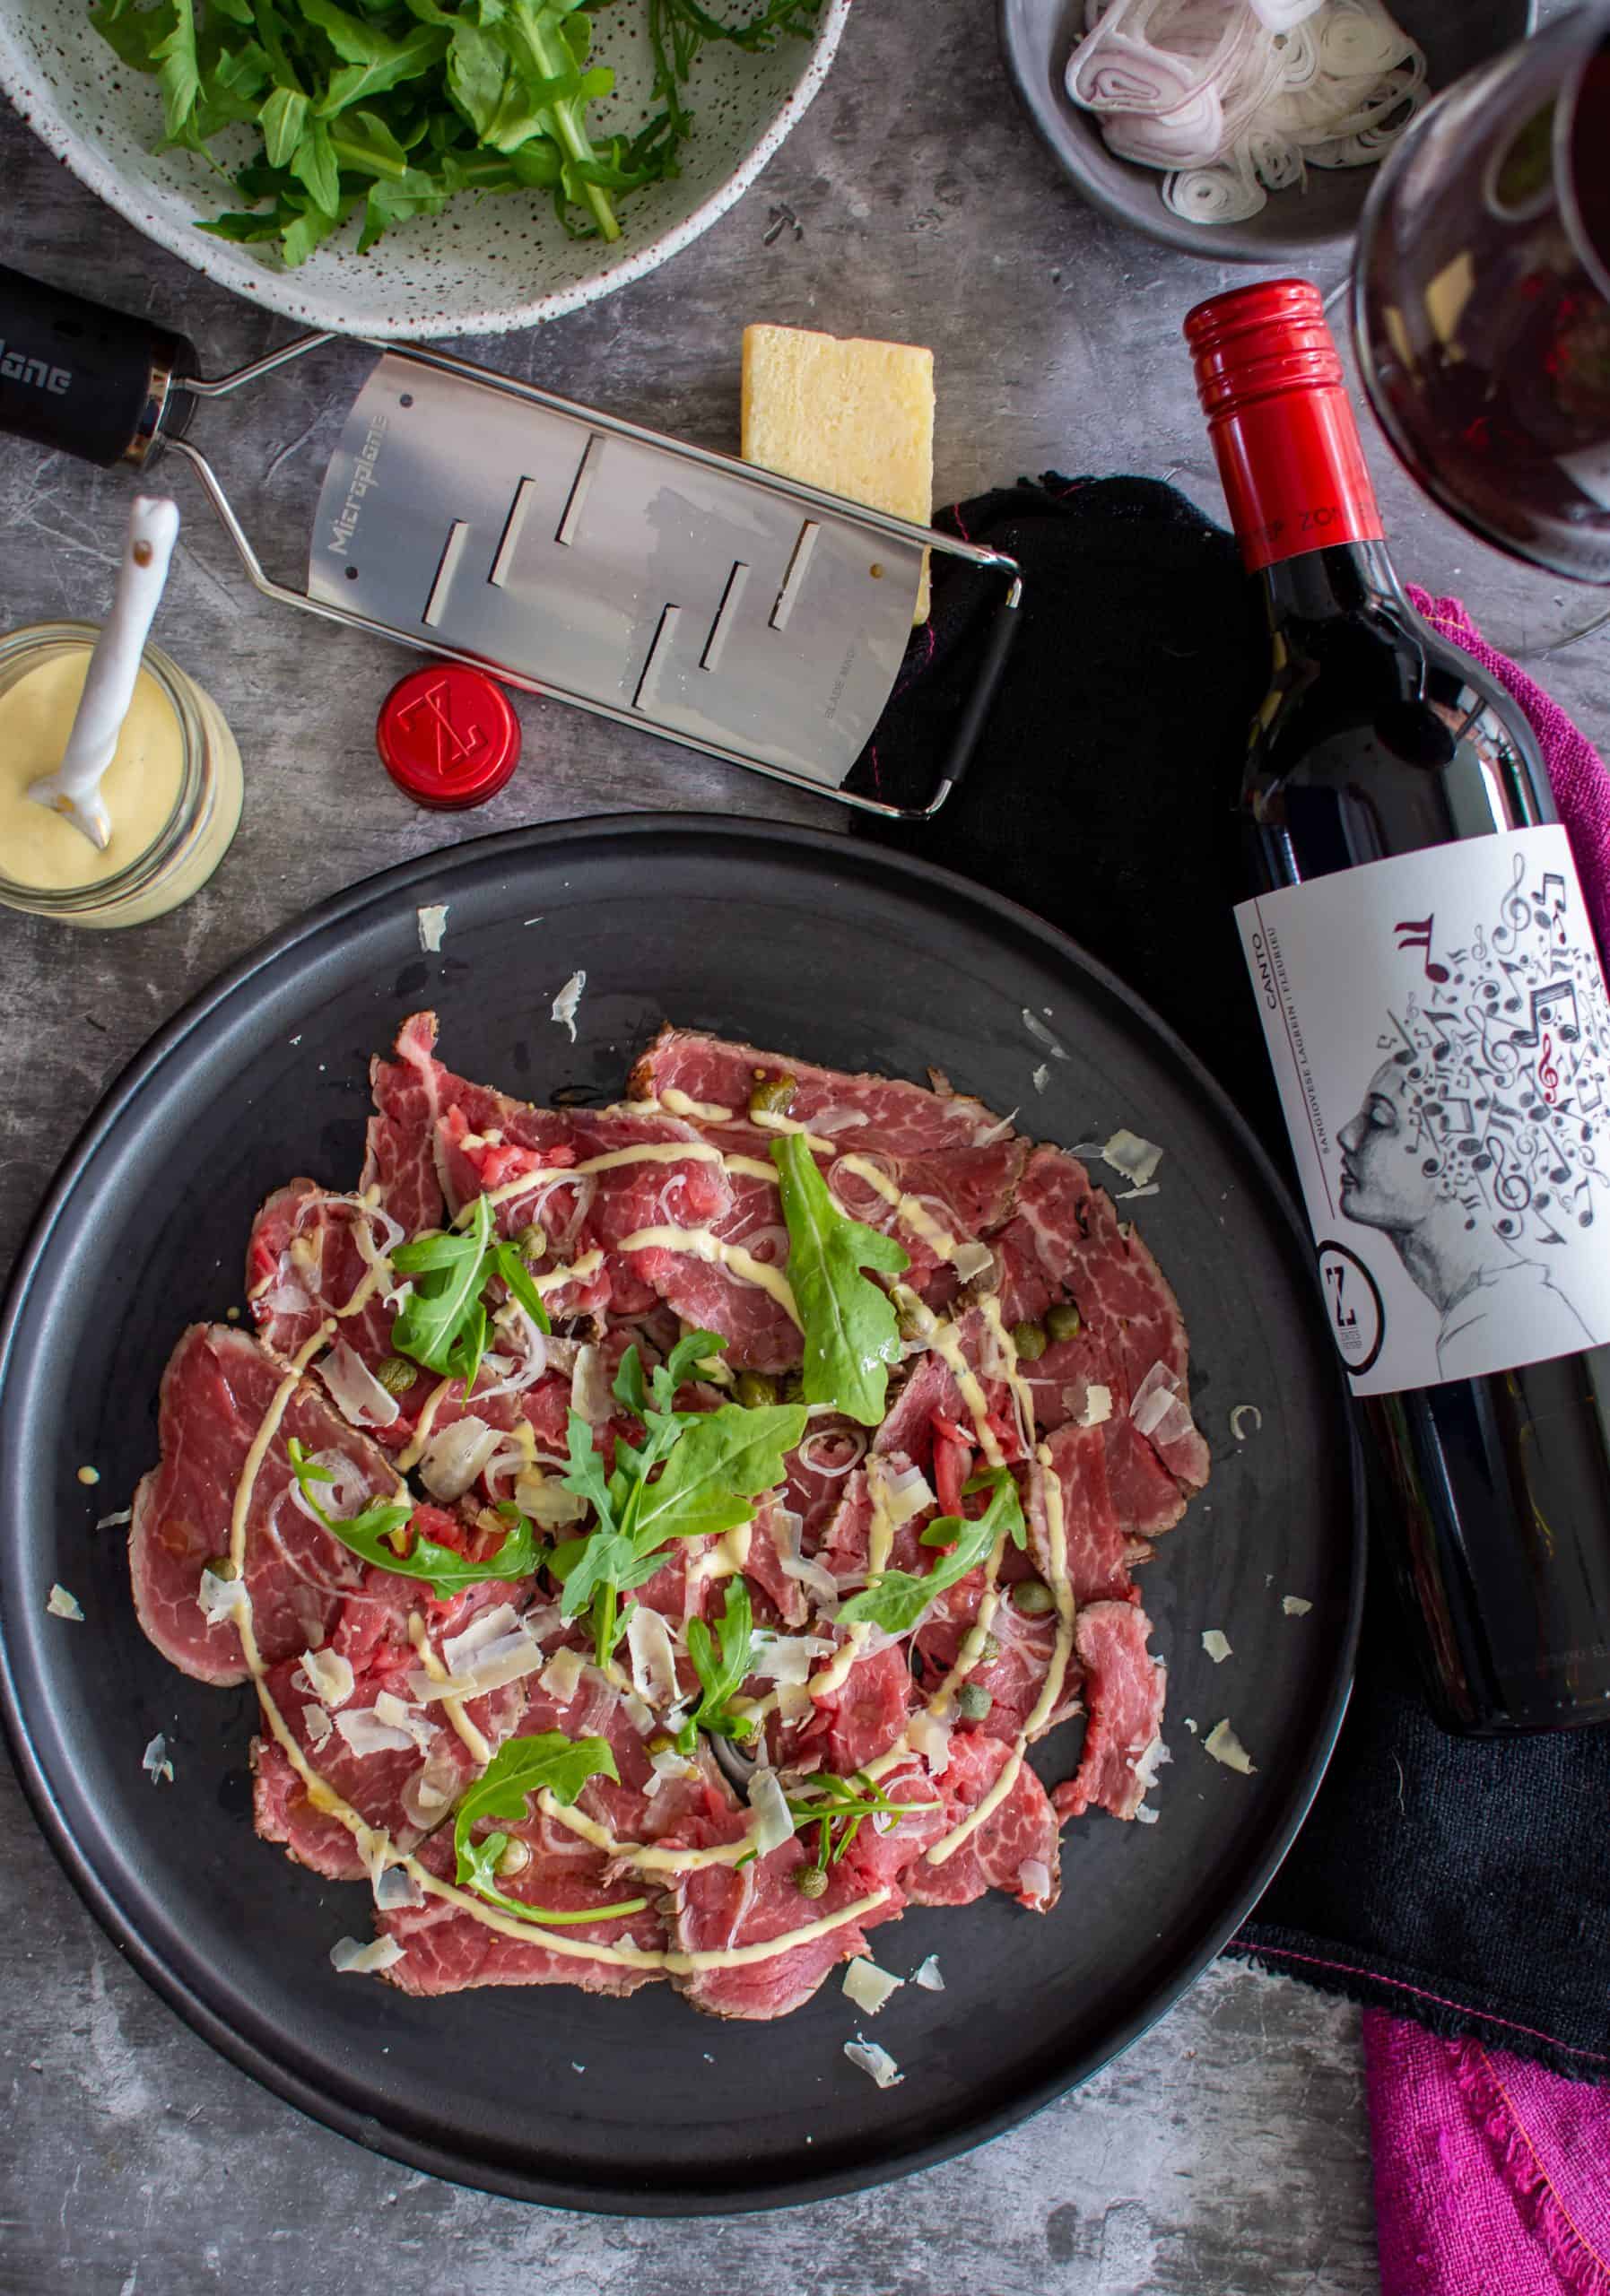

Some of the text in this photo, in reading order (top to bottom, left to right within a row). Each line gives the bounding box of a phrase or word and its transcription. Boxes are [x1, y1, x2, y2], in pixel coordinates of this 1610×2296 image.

[327, 415, 388, 555] Microplane
[1252, 933, 1277, 1010] CANTO
[1266, 926, 1330, 1155] SANGIOVESE LAGREIN FLEURIEU
[1325, 1265, 1356, 1326] Z
